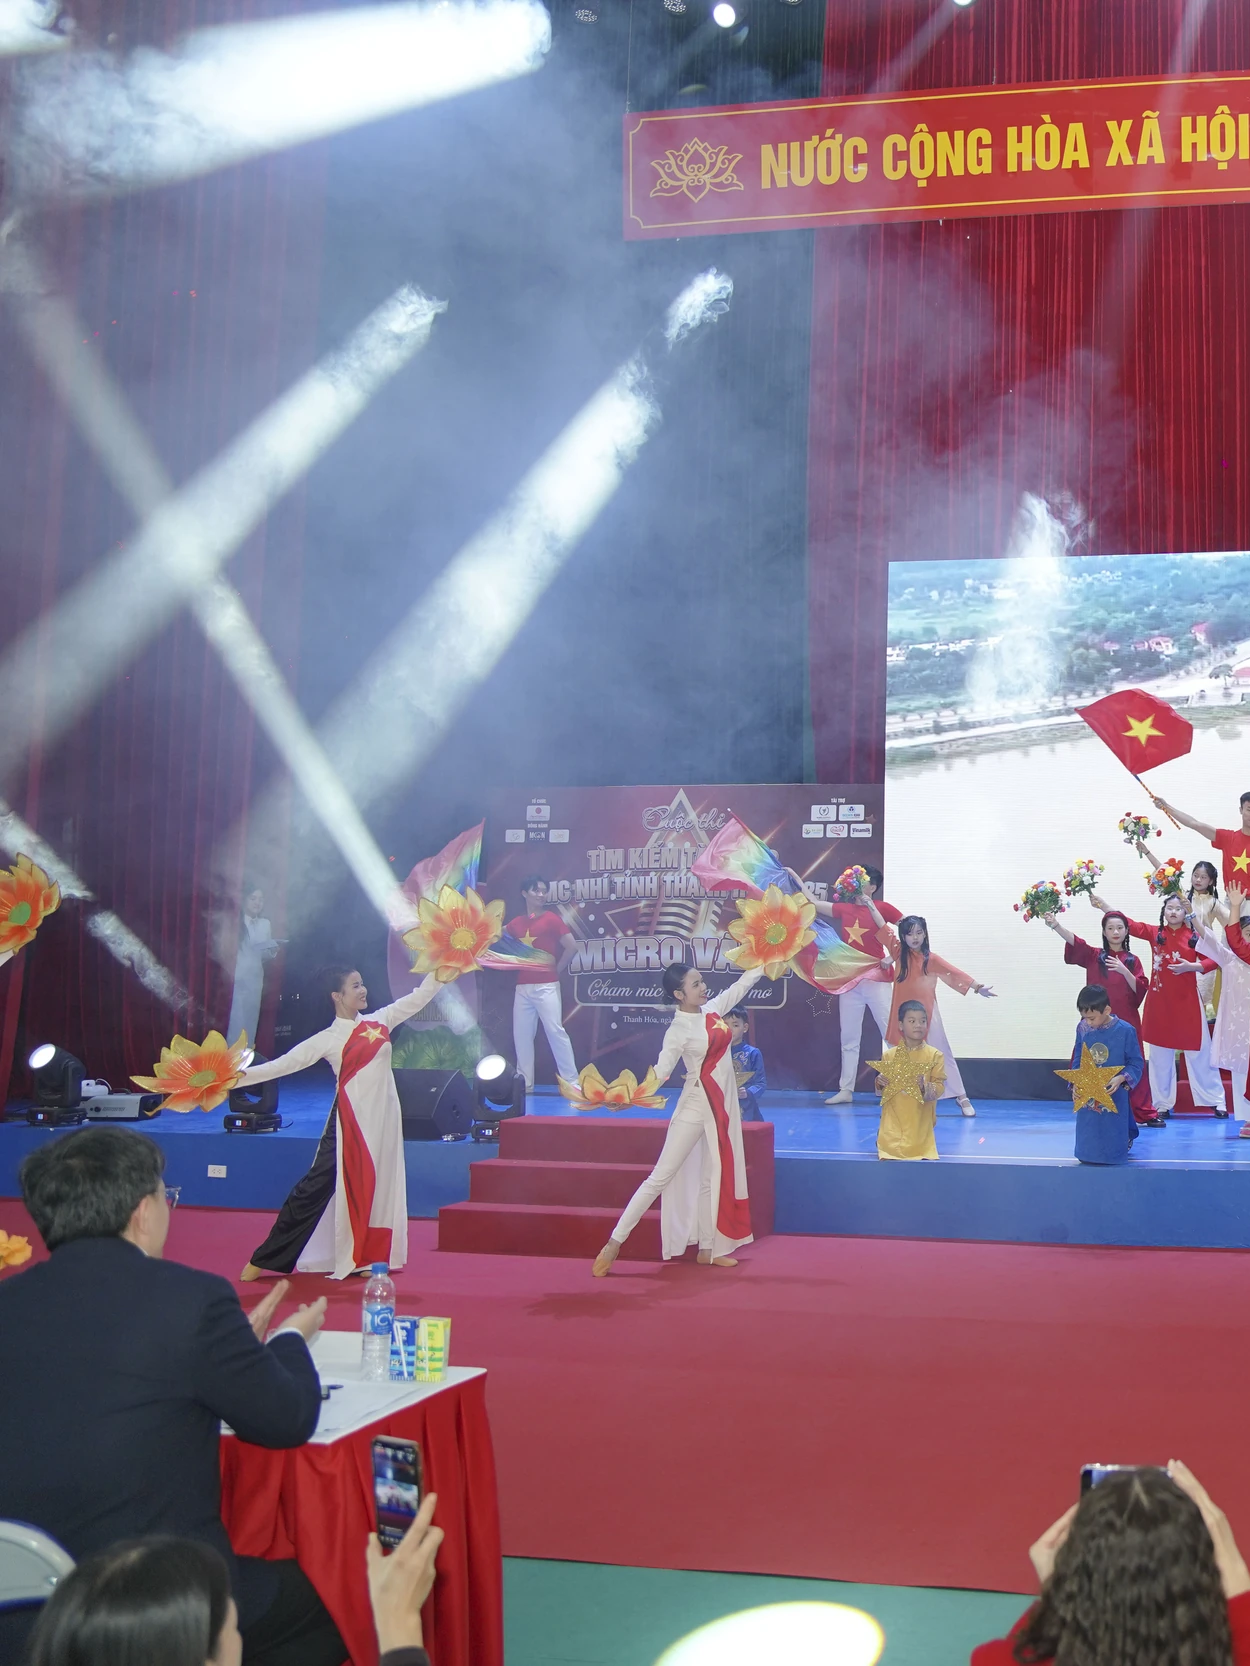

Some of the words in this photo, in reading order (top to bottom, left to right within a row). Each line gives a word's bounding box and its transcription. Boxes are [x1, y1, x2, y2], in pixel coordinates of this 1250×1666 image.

[761, 130, 869, 189] NƯỚC
[882, 124, 993, 188] CỘNG
[1007, 115, 1091, 172] HÒA
[1105, 110, 1165, 166] XÃ
[1181, 105, 1250, 171] HỘI
[642, 806, 696, 833] Cuộc
[698, 807, 726, 831] thi
[587, 845, 625, 873] TÌM
[628, 841, 679, 871] KIẾM
[574, 873, 611, 902] NHÍ
[569, 937, 685, 975] MICRO
[587, 978, 633, 1000] Chạm
[623, 1015, 643, 1023] Thanh
[660, 1016, 674, 1025] ngà
